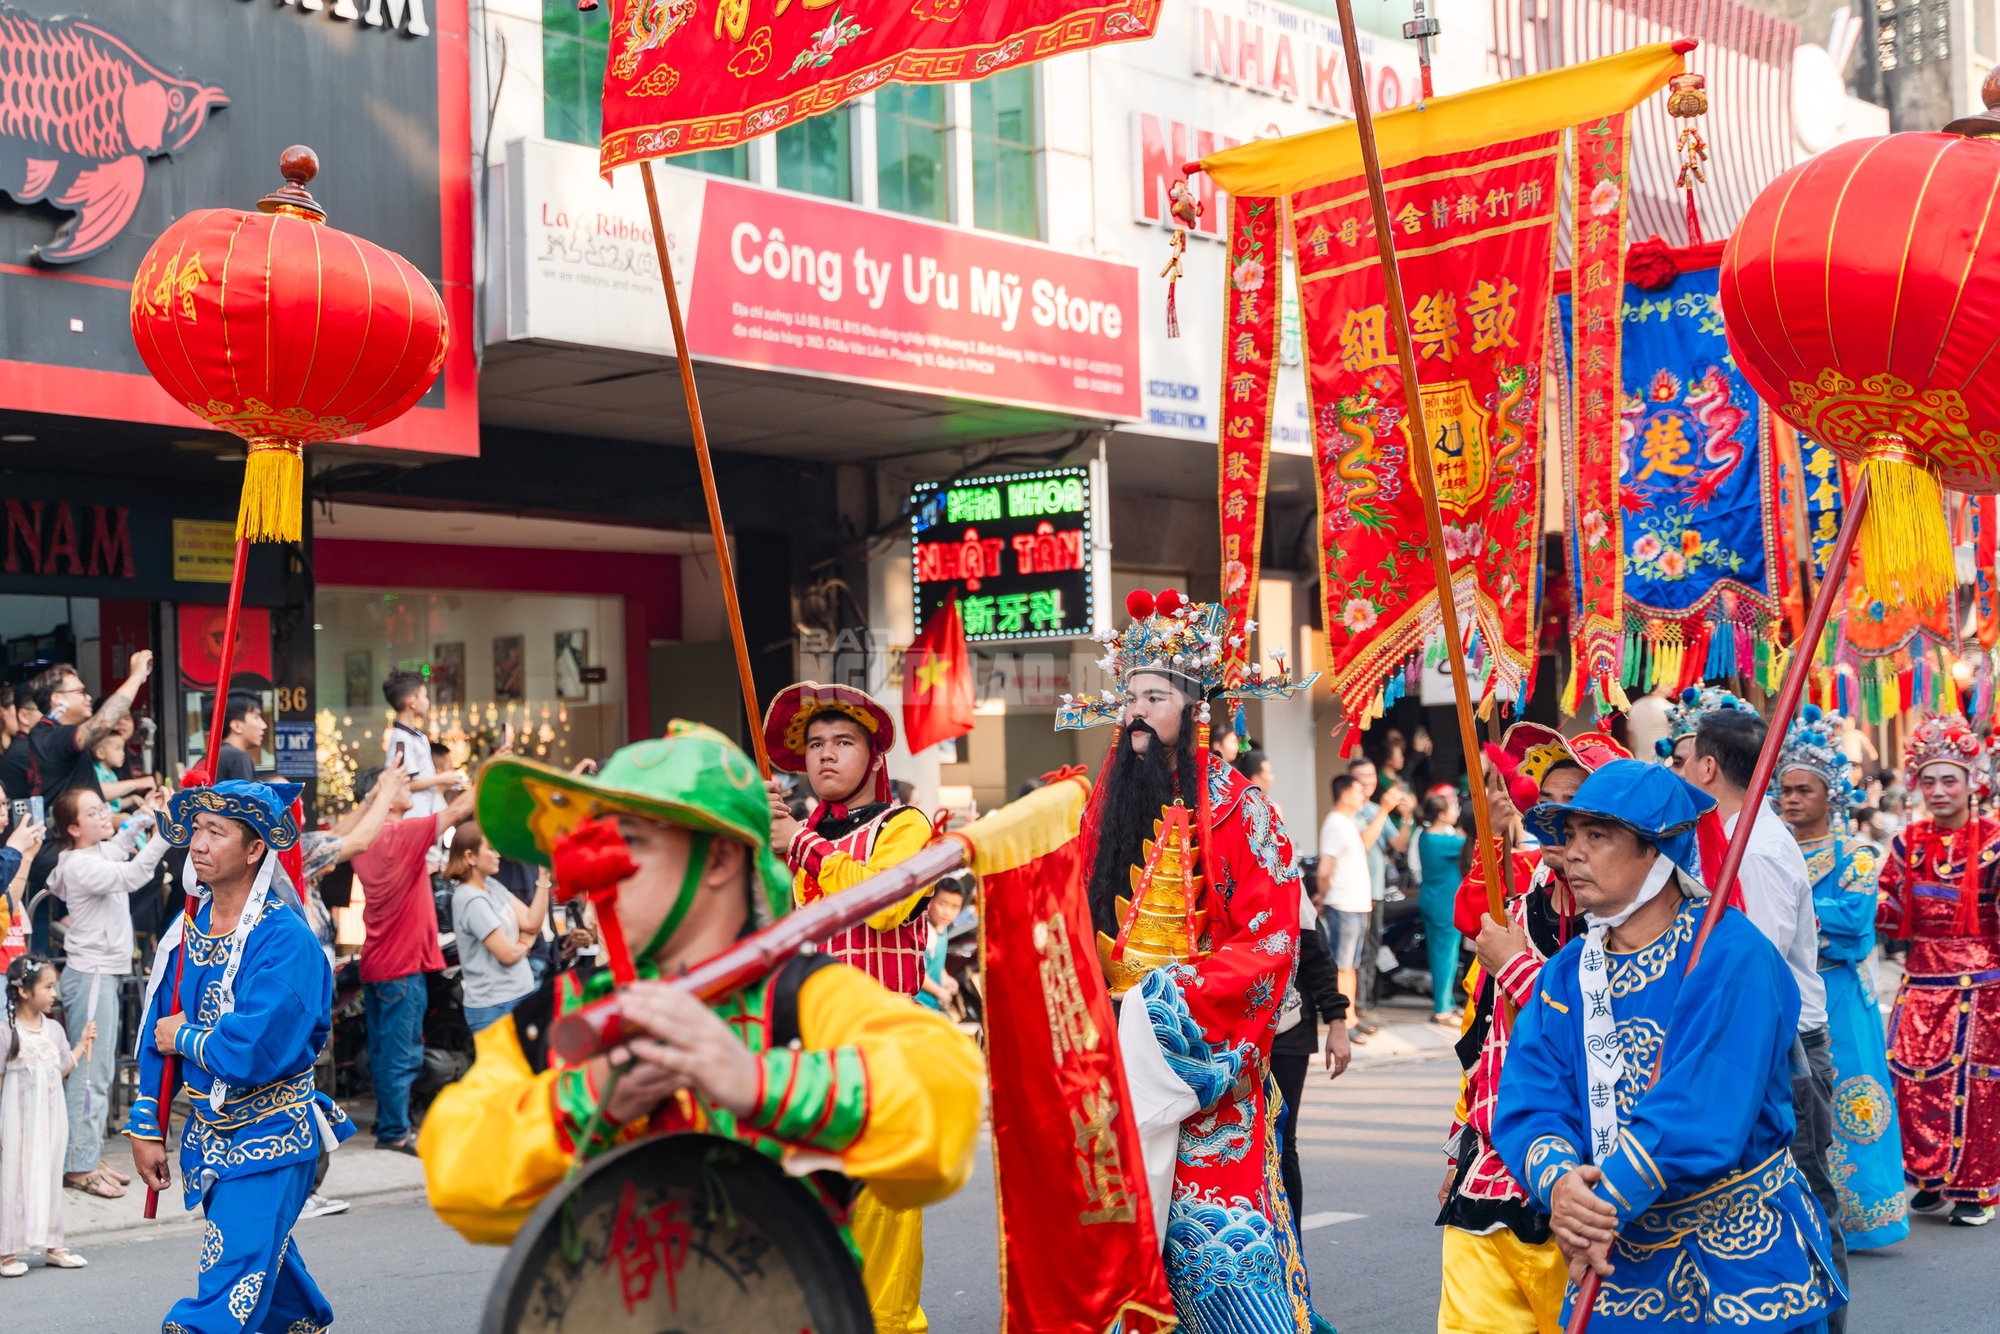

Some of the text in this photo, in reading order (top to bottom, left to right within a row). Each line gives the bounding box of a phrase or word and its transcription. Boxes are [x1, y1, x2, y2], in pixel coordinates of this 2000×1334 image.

[1203, 9, 1299, 97] NHA
[541, 203, 677, 250] La Ribbos
[731, 221, 1123, 340] Công ty Ưu Mỹ Store
[1637, 415, 1694, 481] 楚
[1008, 478, 1084, 518] KHOA
[5, 501, 138, 579] NAM
[915, 520, 1084, 592] NHẬT TÂN
[954, 589, 1065, 635] 新牙科
[278, 686, 308, 712] 36
